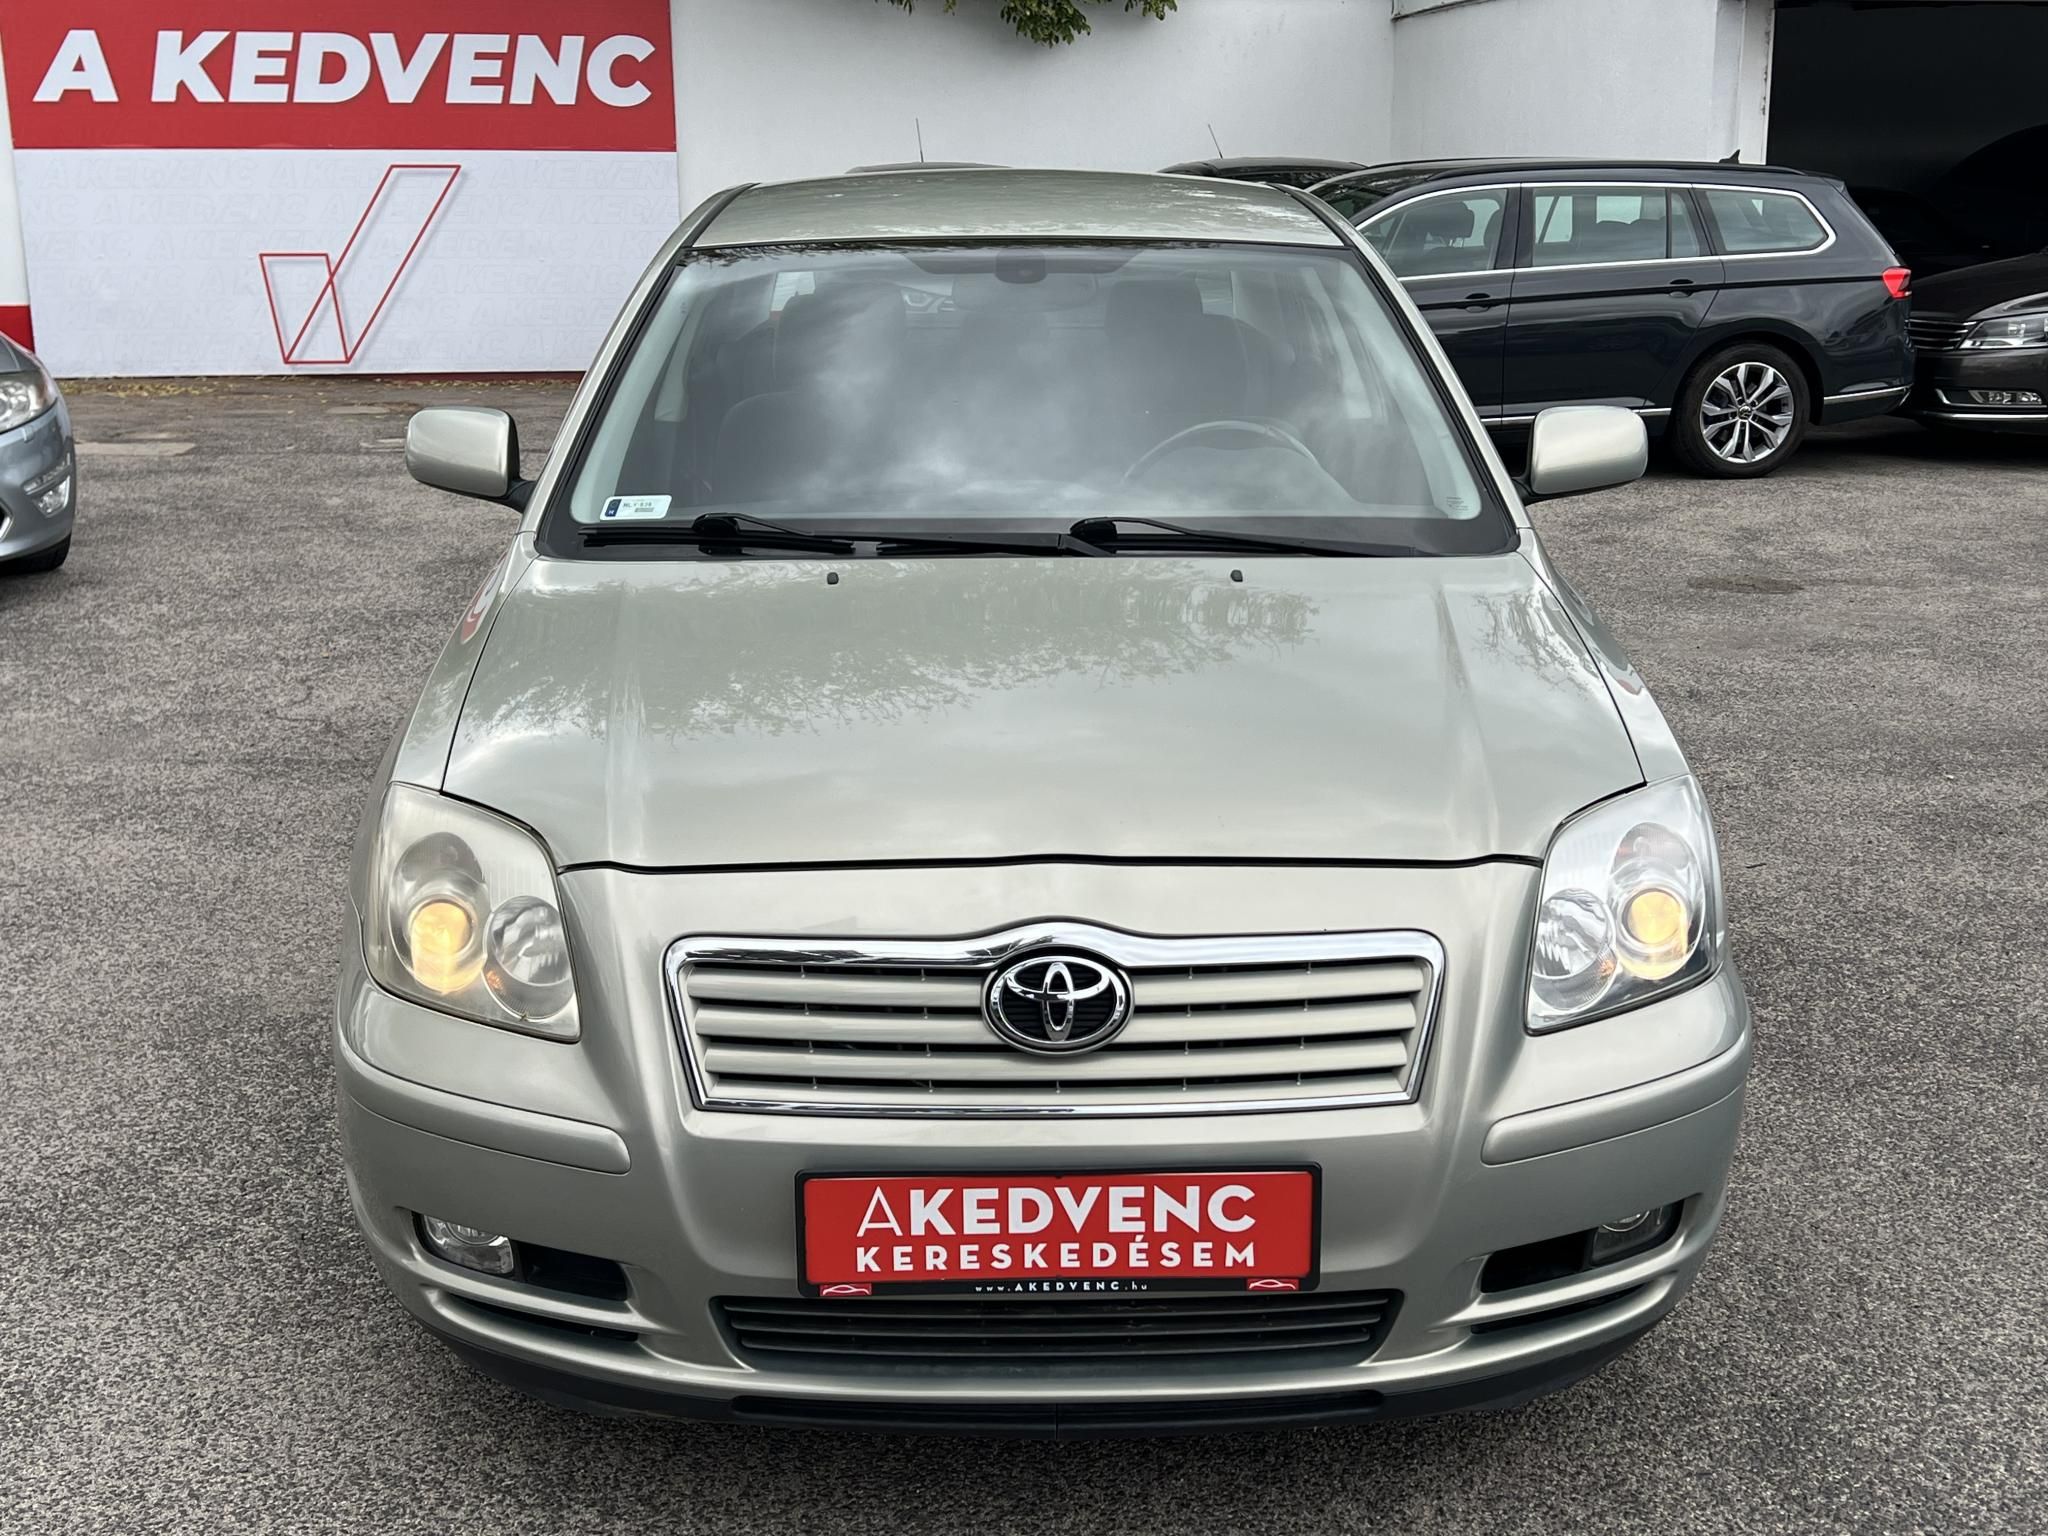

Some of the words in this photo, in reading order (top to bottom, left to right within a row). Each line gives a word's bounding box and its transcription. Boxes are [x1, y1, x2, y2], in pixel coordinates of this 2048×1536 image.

[33, 29, 119, 103] A
[151, 30, 656, 107] KEDVENC
[857, 1234, 1255, 1273] KERESKEDÉSEM
[975, 1280, 1149, 1293] www.AKEDVENC.hu
